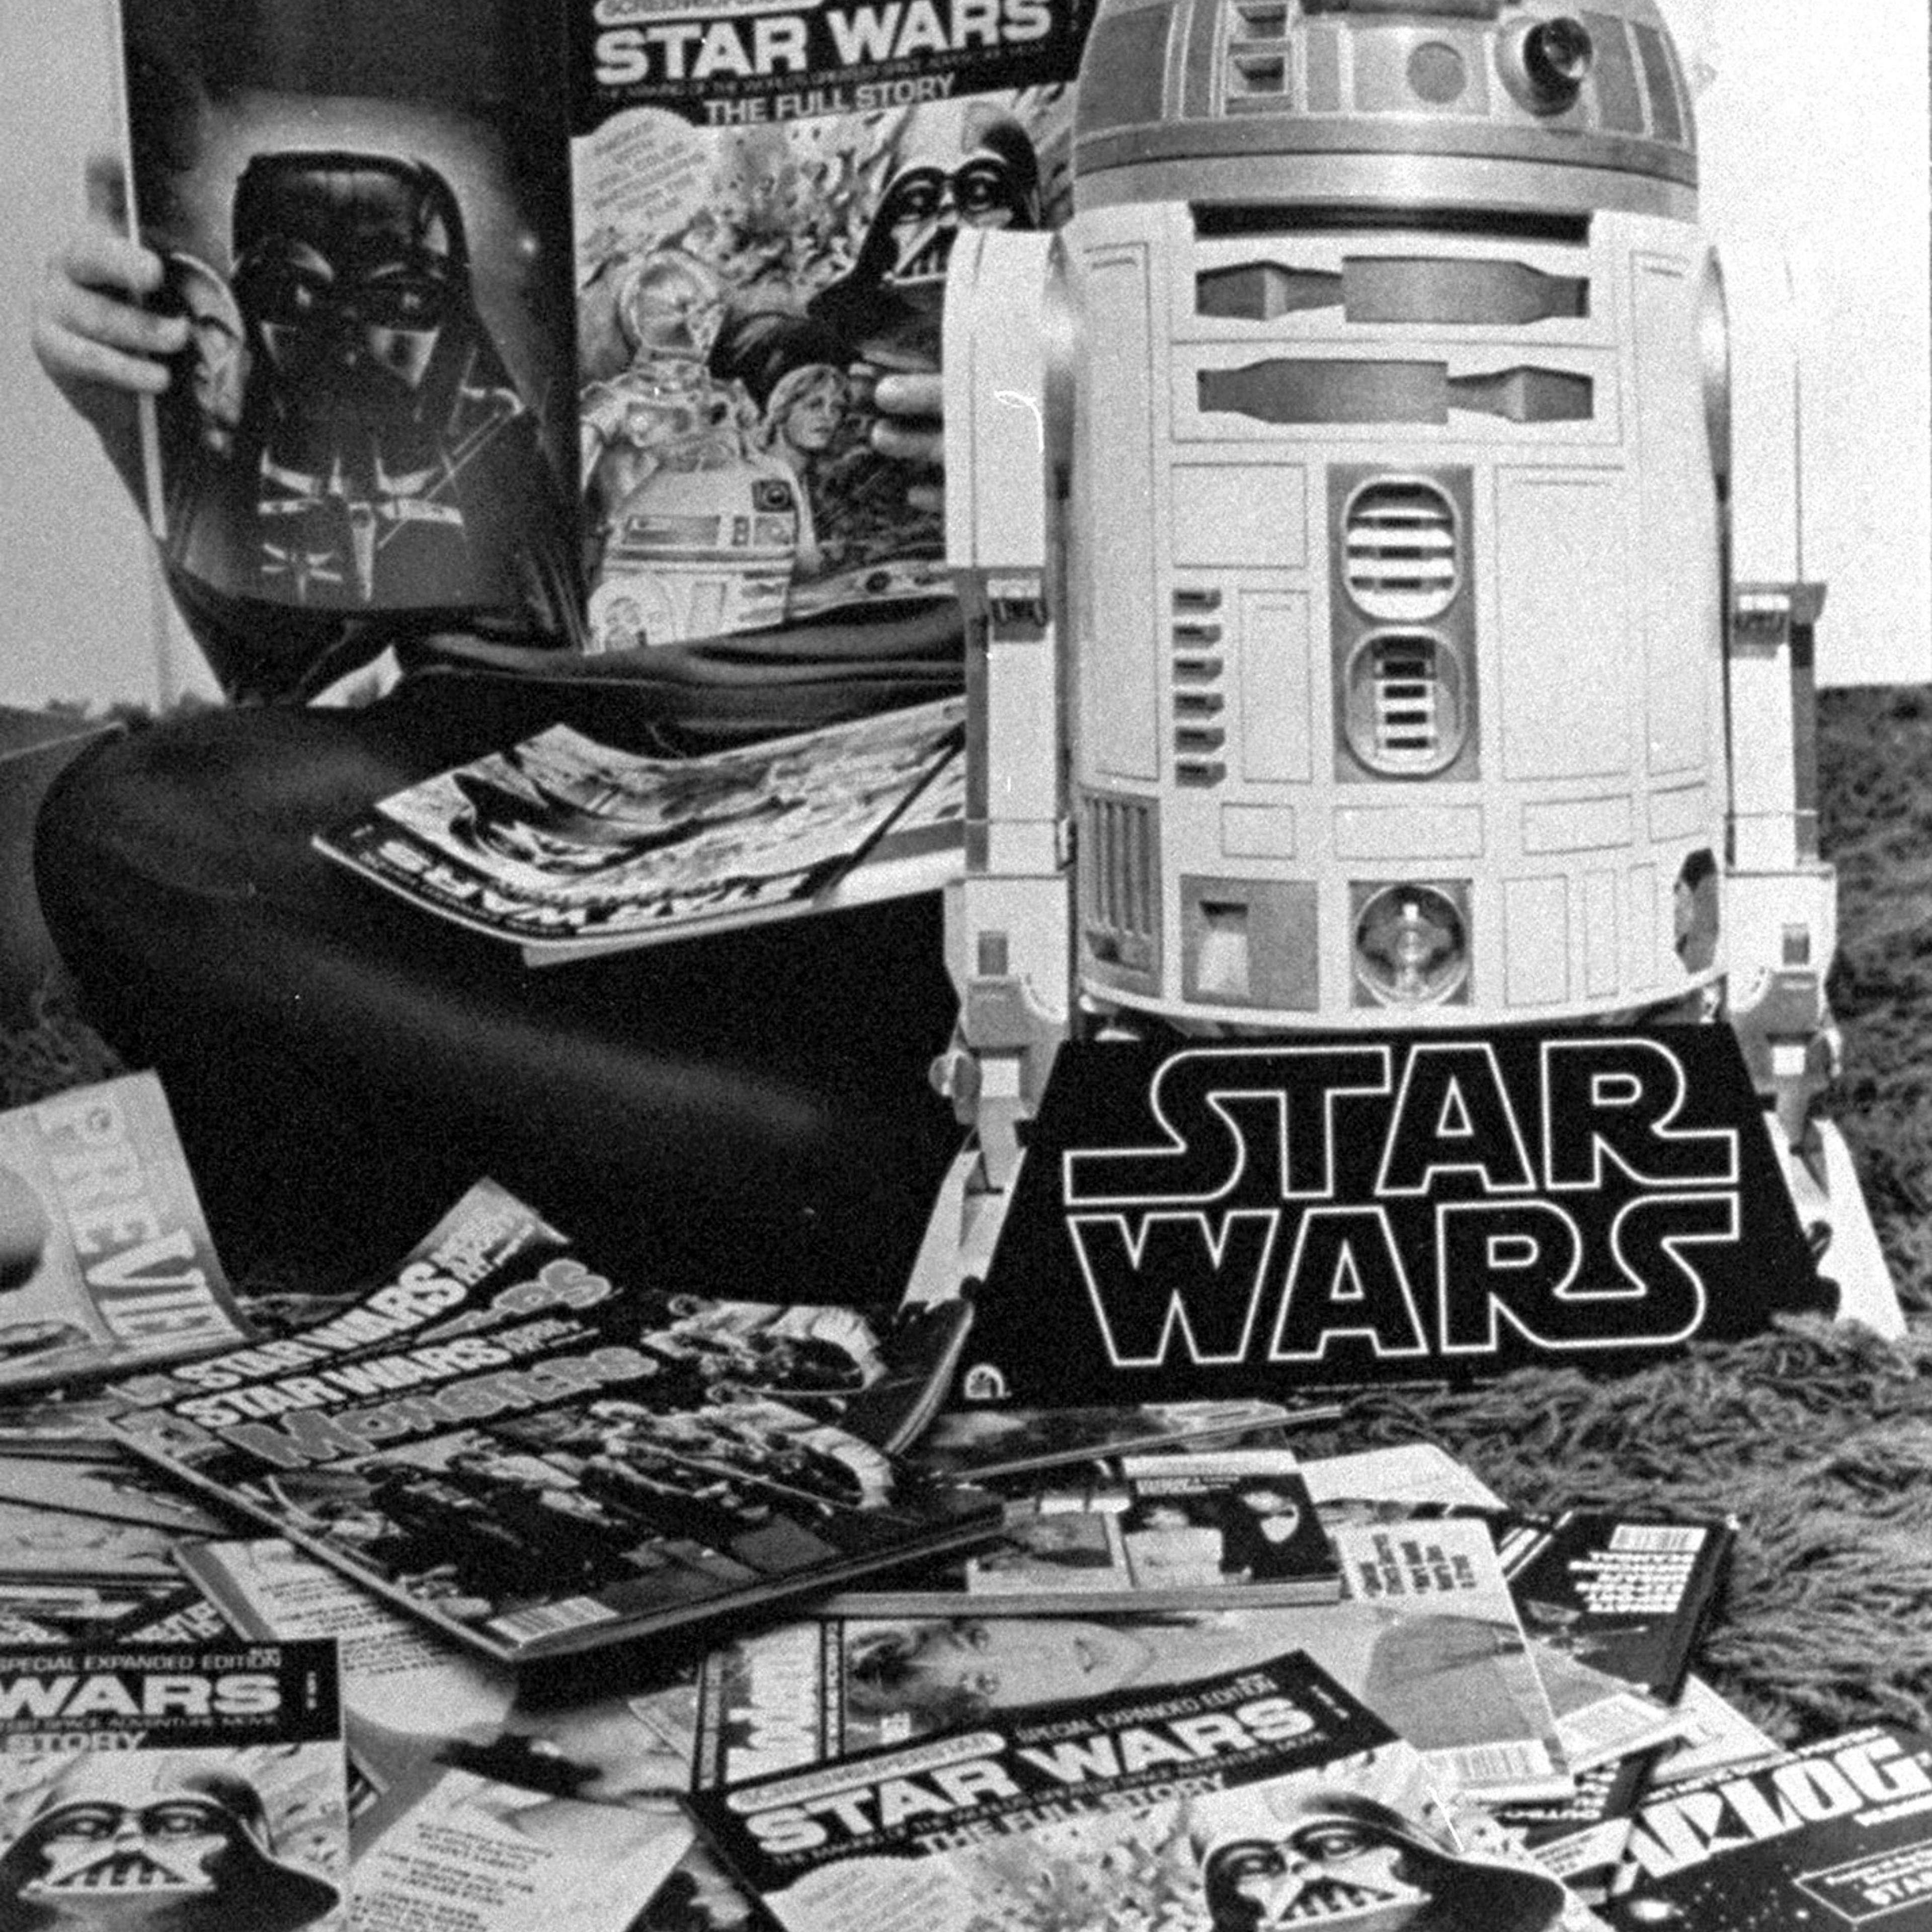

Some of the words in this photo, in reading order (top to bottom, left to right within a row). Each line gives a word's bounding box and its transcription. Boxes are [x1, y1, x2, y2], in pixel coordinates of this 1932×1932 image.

[595, 17, 807, 85] STAR
[827, 0, 1052, 65] WARS
[704, 97, 766, 126] THE
[777, 90, 847, 120] FULL
[855, 73, 955, 109] STORY
[1064, 1037, 1739, 1205] STAR
[1067, 1192, 1739, 1366] WARS
[173, 1338, 334, 1389] STAR
[301, 1261, 468, 1349] WARS
[176, 1376, 347, 1426] STAR
[319, 1337, 512, 1395] WARS
[0, 1675, 280, 1718] WARS
[85, 1656, 194, 1670] EXPANDED
[7, 1731, 147, 1753] STORY
[1096, 1697, 1197, 1728] EXPANDED
[745, 1759, 1020, 1854] STAR
[1017, 1697, 1315, 1783] WARS
[913, 1821, 994, 1855] THE
[1006, 1798, 1094, 1832] FULL
[1102, 1772, 1226, 1812] STORY
